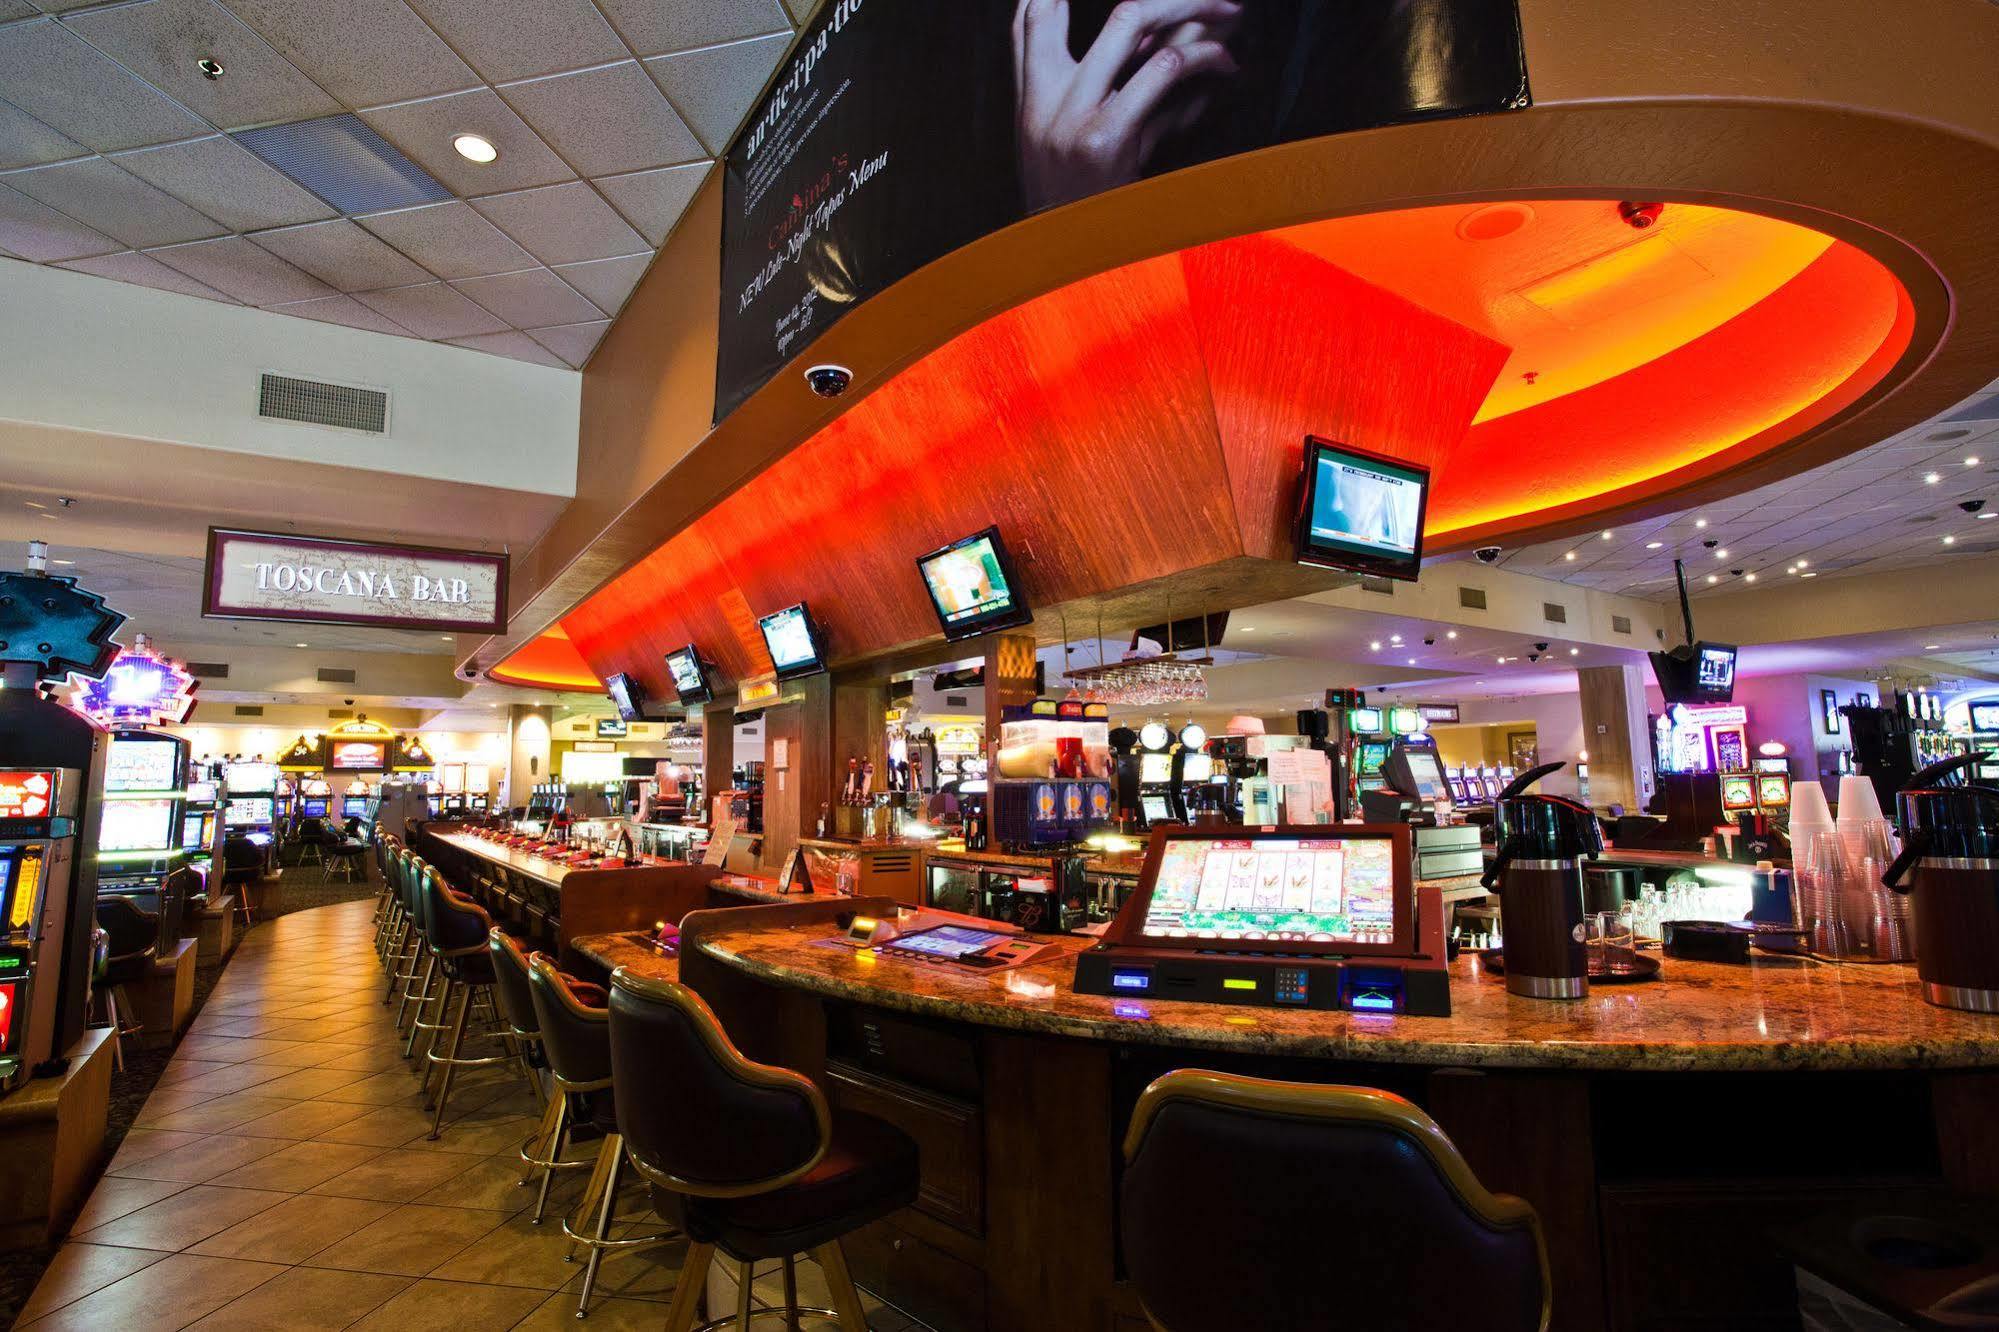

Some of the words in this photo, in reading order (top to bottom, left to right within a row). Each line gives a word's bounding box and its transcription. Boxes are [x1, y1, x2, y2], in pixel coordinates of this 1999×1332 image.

[738, 267, 766, 314] NEW
[848, 150, 889, 195] Menu
[255, 562, 398, 600] TOSCANA
[412, 575, 470, 604] BAR
